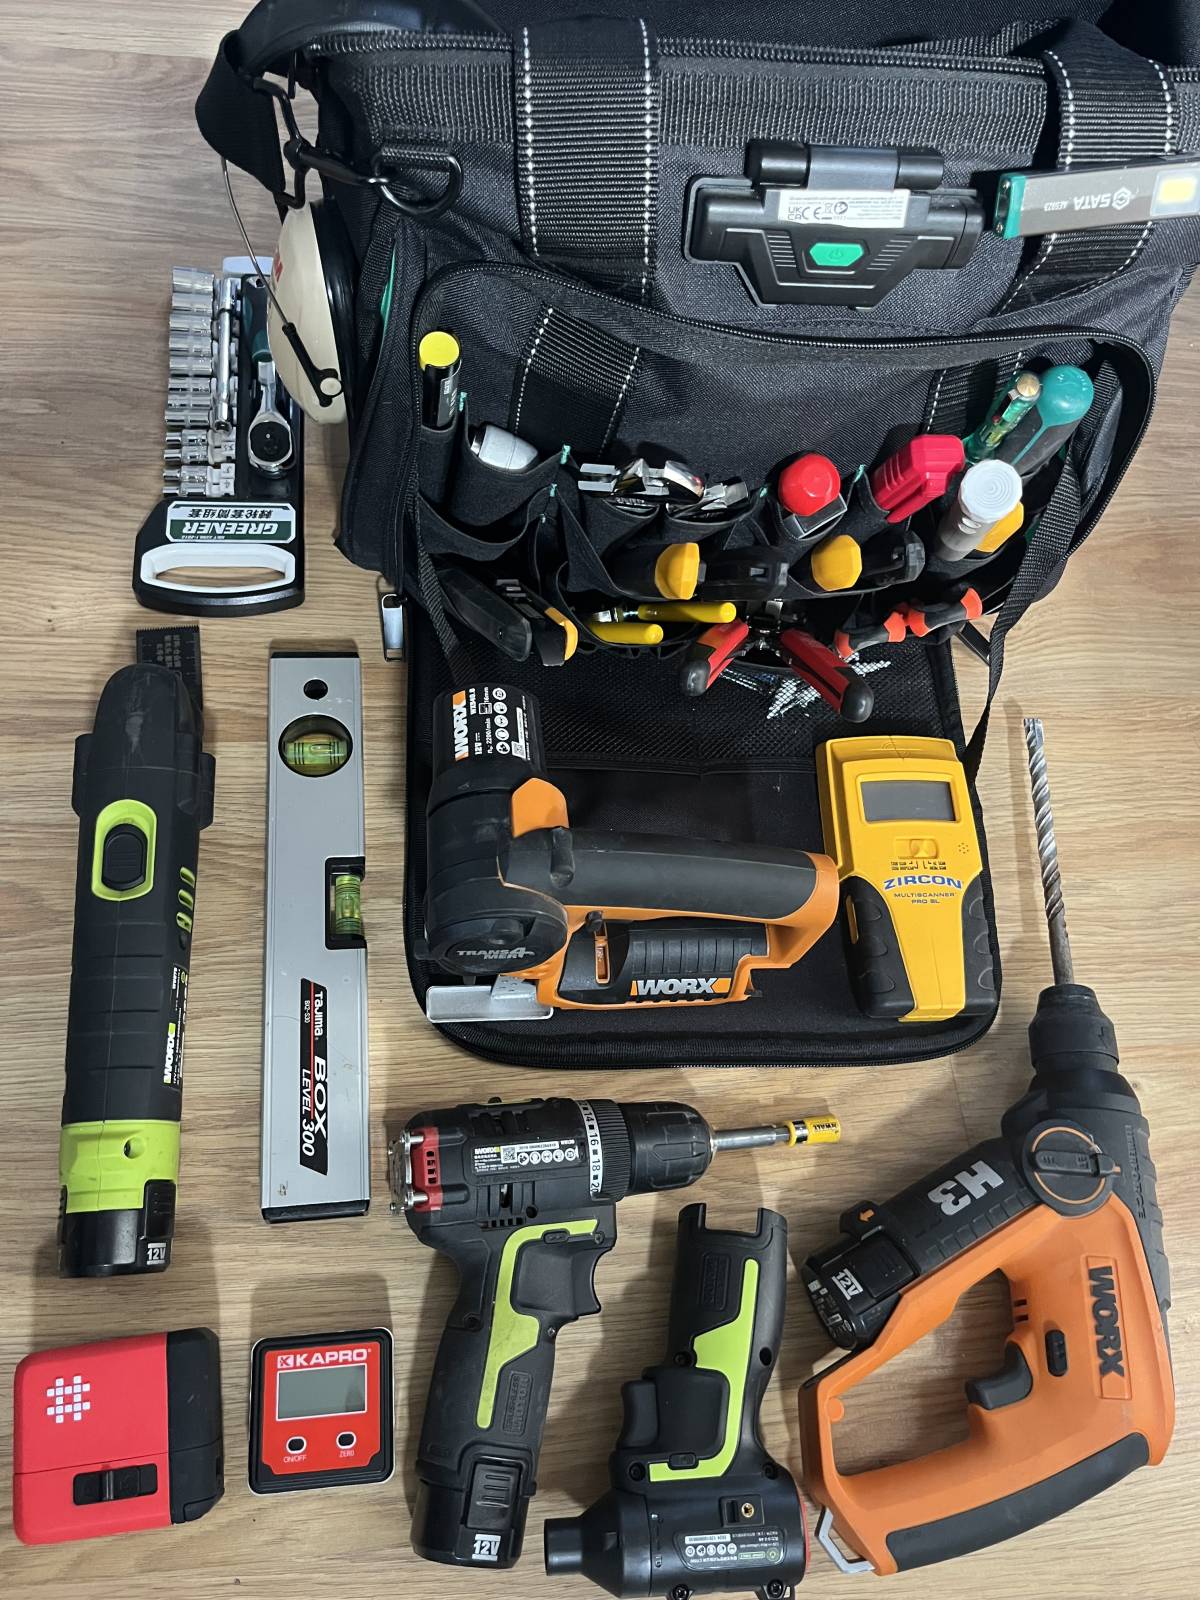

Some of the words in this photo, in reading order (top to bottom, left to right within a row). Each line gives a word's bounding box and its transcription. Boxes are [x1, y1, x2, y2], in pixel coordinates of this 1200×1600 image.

[1073, 193, 1112, 211] SATA
[182, 521, 279, 535] GREENER
[453, 704, 469, 756] WORX
[474, 742, 483, 756] 12V
[883, 875, 962, 890] ZIRCON
[636, 977, 718, 996] WORX
[163, 1031, 176, 1079] WORX
[302, 1068, 311, 1115] LEVEL
[314, 1055, 326, 1140] BOX
[584, 1111, 594, 1122] 14
[301, 1118, 315, 1157] 300
[589, 1132, 599, 1146] 16
[592, 1158, 601, 1172] 18
[590, 1182, 600, 1193] 20
[926, 1159, 1005, 1216] H3
[147, 1248, 166, 1261] 12V
[835, 1271, 859, 1296] 12V
[1087, 1265, 1126, 1377] WORX
[295, 1348, 367, 1367] KAPRO
[283, 1454, 307, 1464] ON/OFF
[339, 1449, 355, 1458] ZERO
[473, 1539, 499, 1557] 12V
